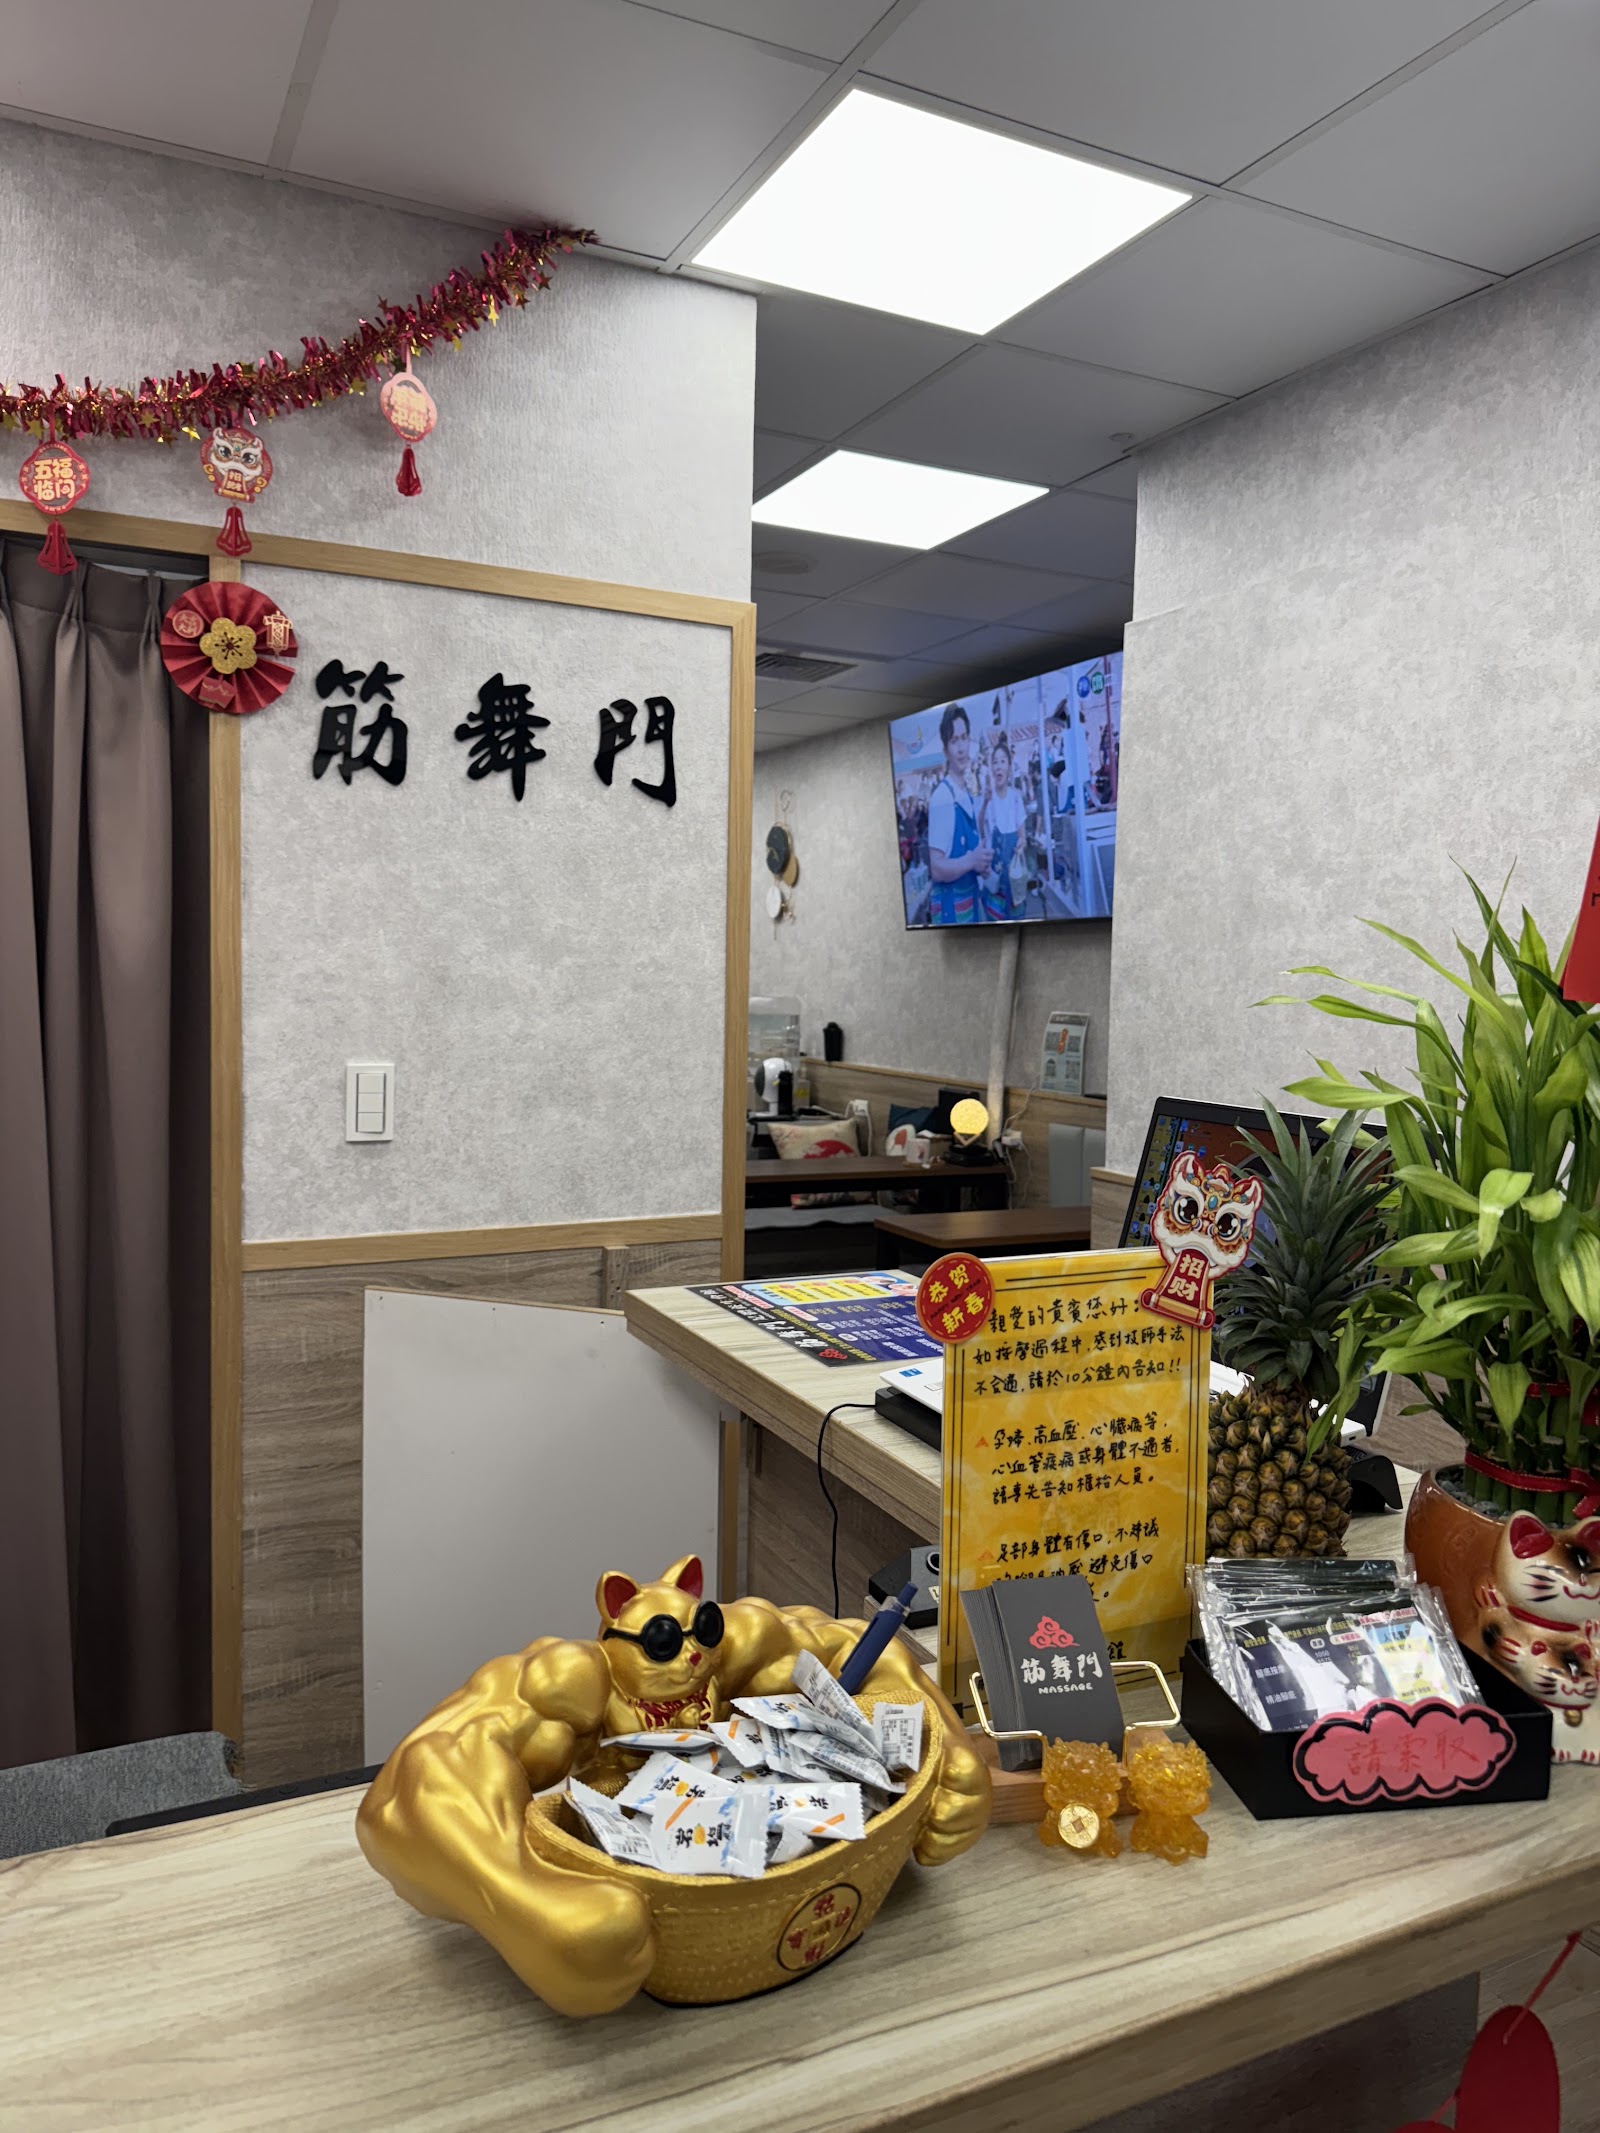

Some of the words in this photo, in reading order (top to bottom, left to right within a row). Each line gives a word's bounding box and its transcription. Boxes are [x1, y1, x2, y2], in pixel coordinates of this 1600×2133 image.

[34, 457, 74, 480] 五福
[312, 659, 677, 808] 筋舞門
[929, 1263, 970, 1304] 恭贺
[1167, 1253, 1206, 1301] 招财
[942, 1292, 985, 1334] 新春
[1020, 1651, 1103, 1684] 筋舞門
[1038, 1682, 1093, 1694] MASSAGE
